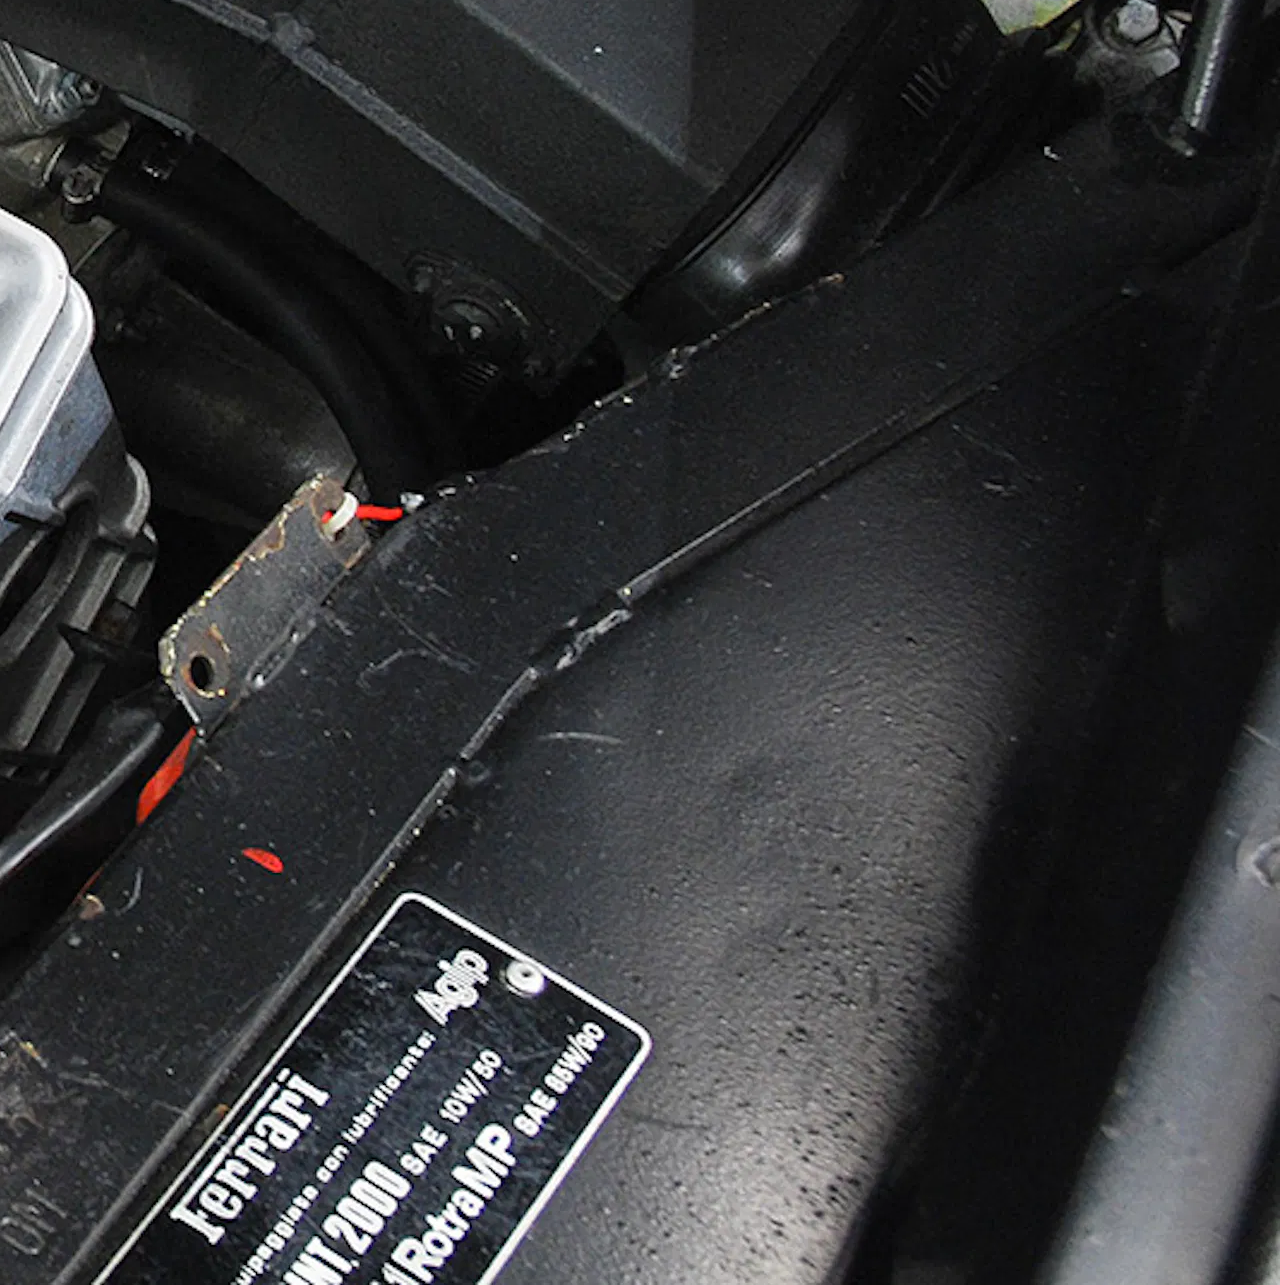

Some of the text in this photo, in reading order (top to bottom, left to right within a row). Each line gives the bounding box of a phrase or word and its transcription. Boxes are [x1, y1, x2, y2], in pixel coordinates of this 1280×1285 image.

[412, 947, 490, 1027] Agip
[170, 1067, 330, 1246] Ferrari
[321, 1160, 413, 1256] 2000
[399, 1121, 450, 1177] SAE
[439, 1048, 503, 1124] 10W/50
[512, 1087, 559, 1138] SAE
[230, 1184, 320, 1285] uipaggiata
[315, 1143, 350, 1184] con
